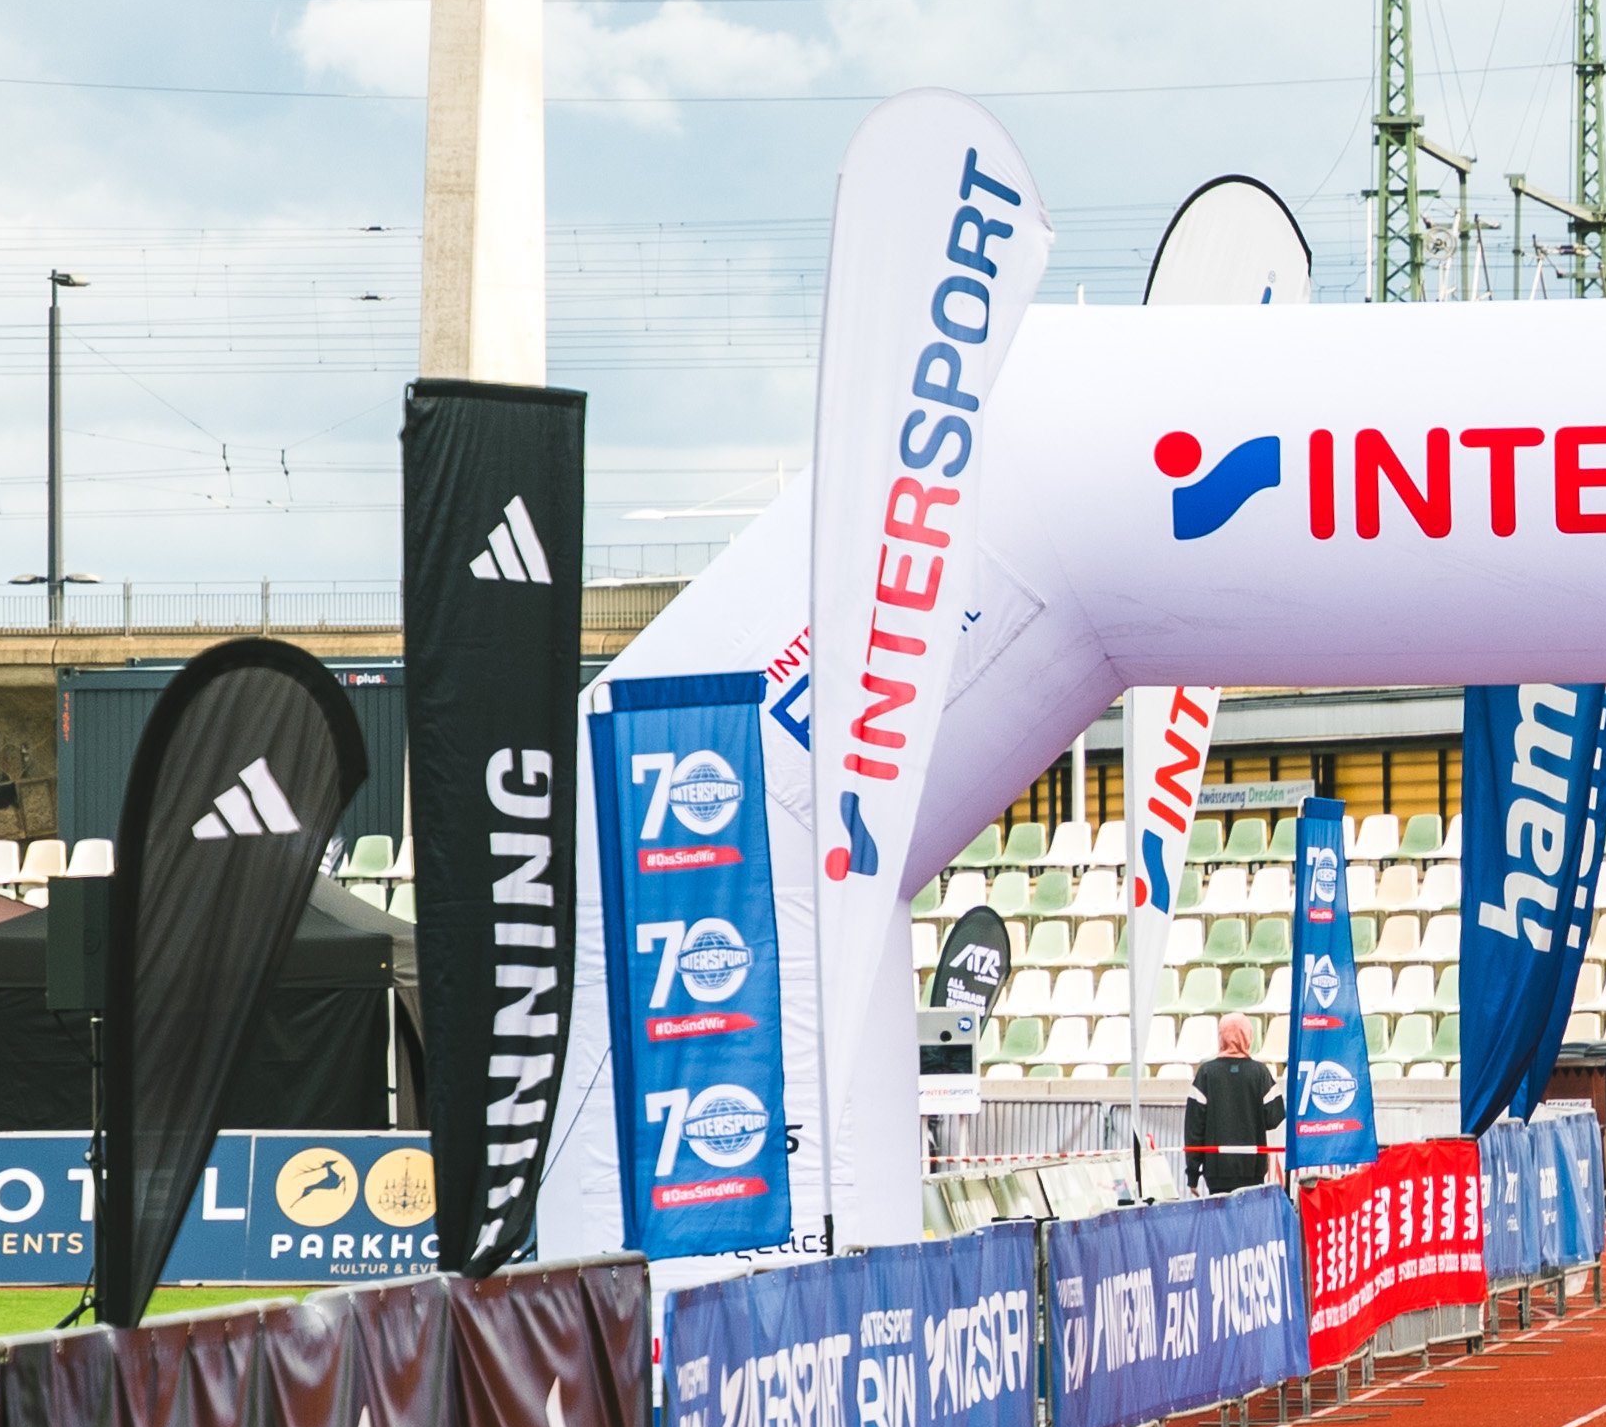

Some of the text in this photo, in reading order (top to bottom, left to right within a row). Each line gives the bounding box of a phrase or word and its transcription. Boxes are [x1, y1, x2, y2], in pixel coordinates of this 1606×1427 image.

[844, 146, 1023, 782] INTERSPORT
[631, 749, 741, 840] 70
[670, 780, 742, 803] INTERSPORT
[636, 917, 748, 1009] 70
[645, 1083, 767, 1177] 70
[685, 1113, 768, 1138] INTERSPORT
[661, 1182, 746, 1203] #DasSindWir
[270, 1233, 441, 1259] PARKHO
[330, 1264, 439, 1275] KULTUR & EVE
